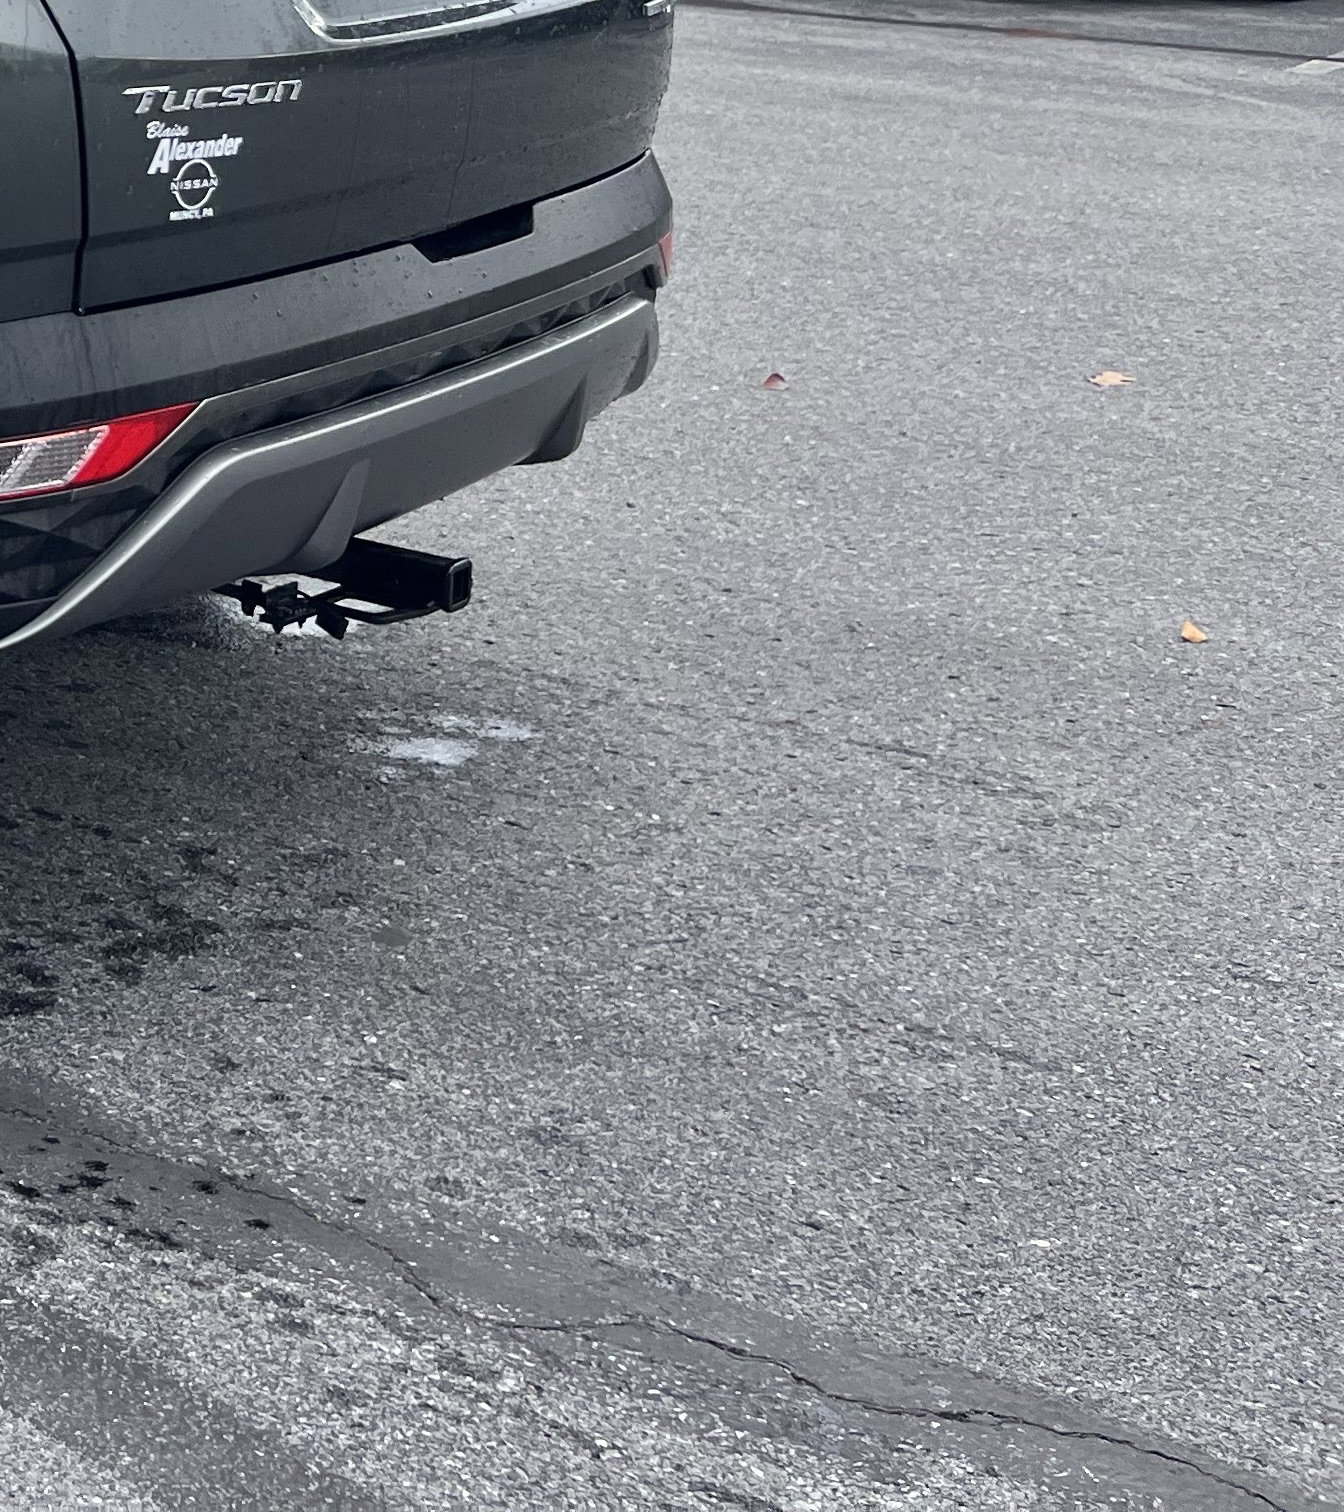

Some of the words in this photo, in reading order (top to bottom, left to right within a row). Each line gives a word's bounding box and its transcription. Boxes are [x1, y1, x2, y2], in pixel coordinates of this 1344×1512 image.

[146, 120, 189, 139] Blaise
[146, 133, 243, 175] Alexander
[170, 178, 219, 191] NISSAN
